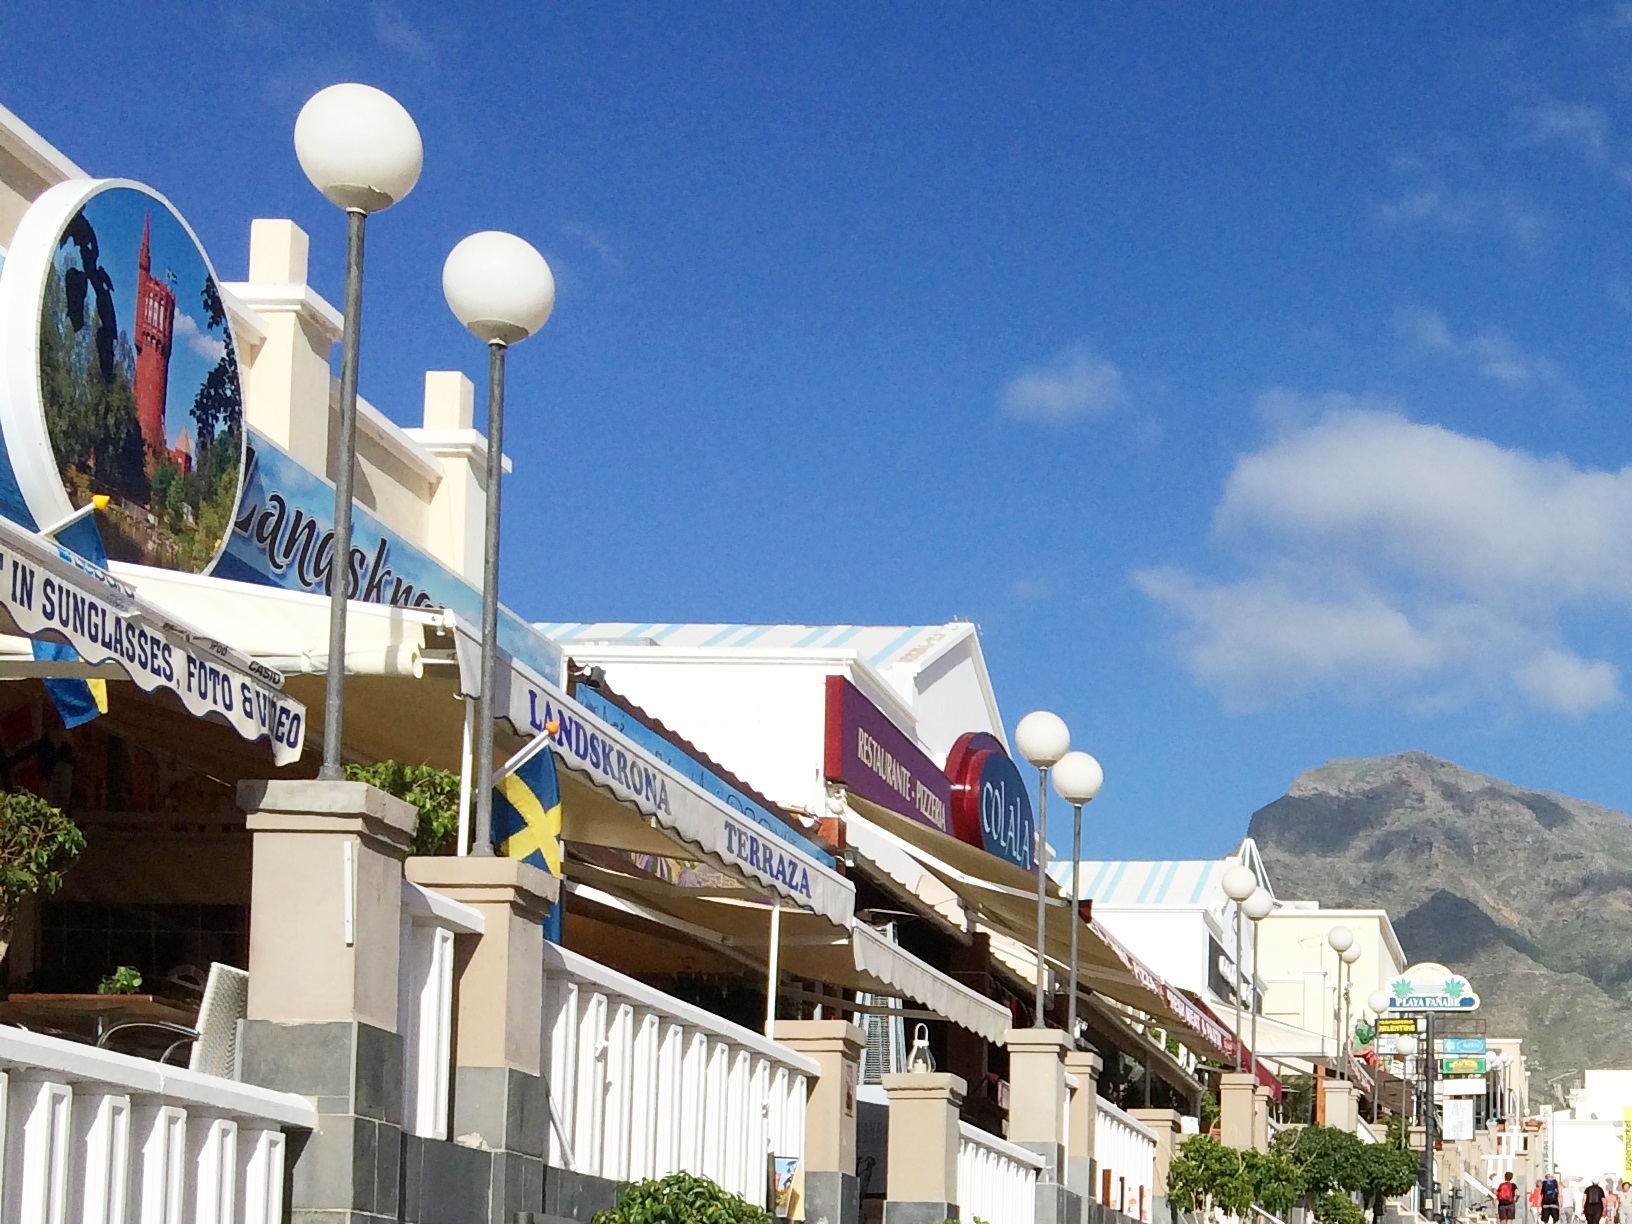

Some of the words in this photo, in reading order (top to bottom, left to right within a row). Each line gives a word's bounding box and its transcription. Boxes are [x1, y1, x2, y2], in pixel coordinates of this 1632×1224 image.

[11, 560, 35, 611] IN
[187, 653, 234, 712] FOTO
[255, 690, 301, 749] VDEO
[248, 660, 281, 685] CASIO
[528, 689, 672, 816] LANDSKRONA
[724, 820, 812, 899] TERRAZA
[857, 727, 911, 801] RESTAURANTE
[916, 780, 947, 832] PIZZERIA
[982, 780, 1031, 871] COLALA
[1395, 997, 1424, 1007] PLAYA
[1624, 1120, 1632, 1171] supermarket
